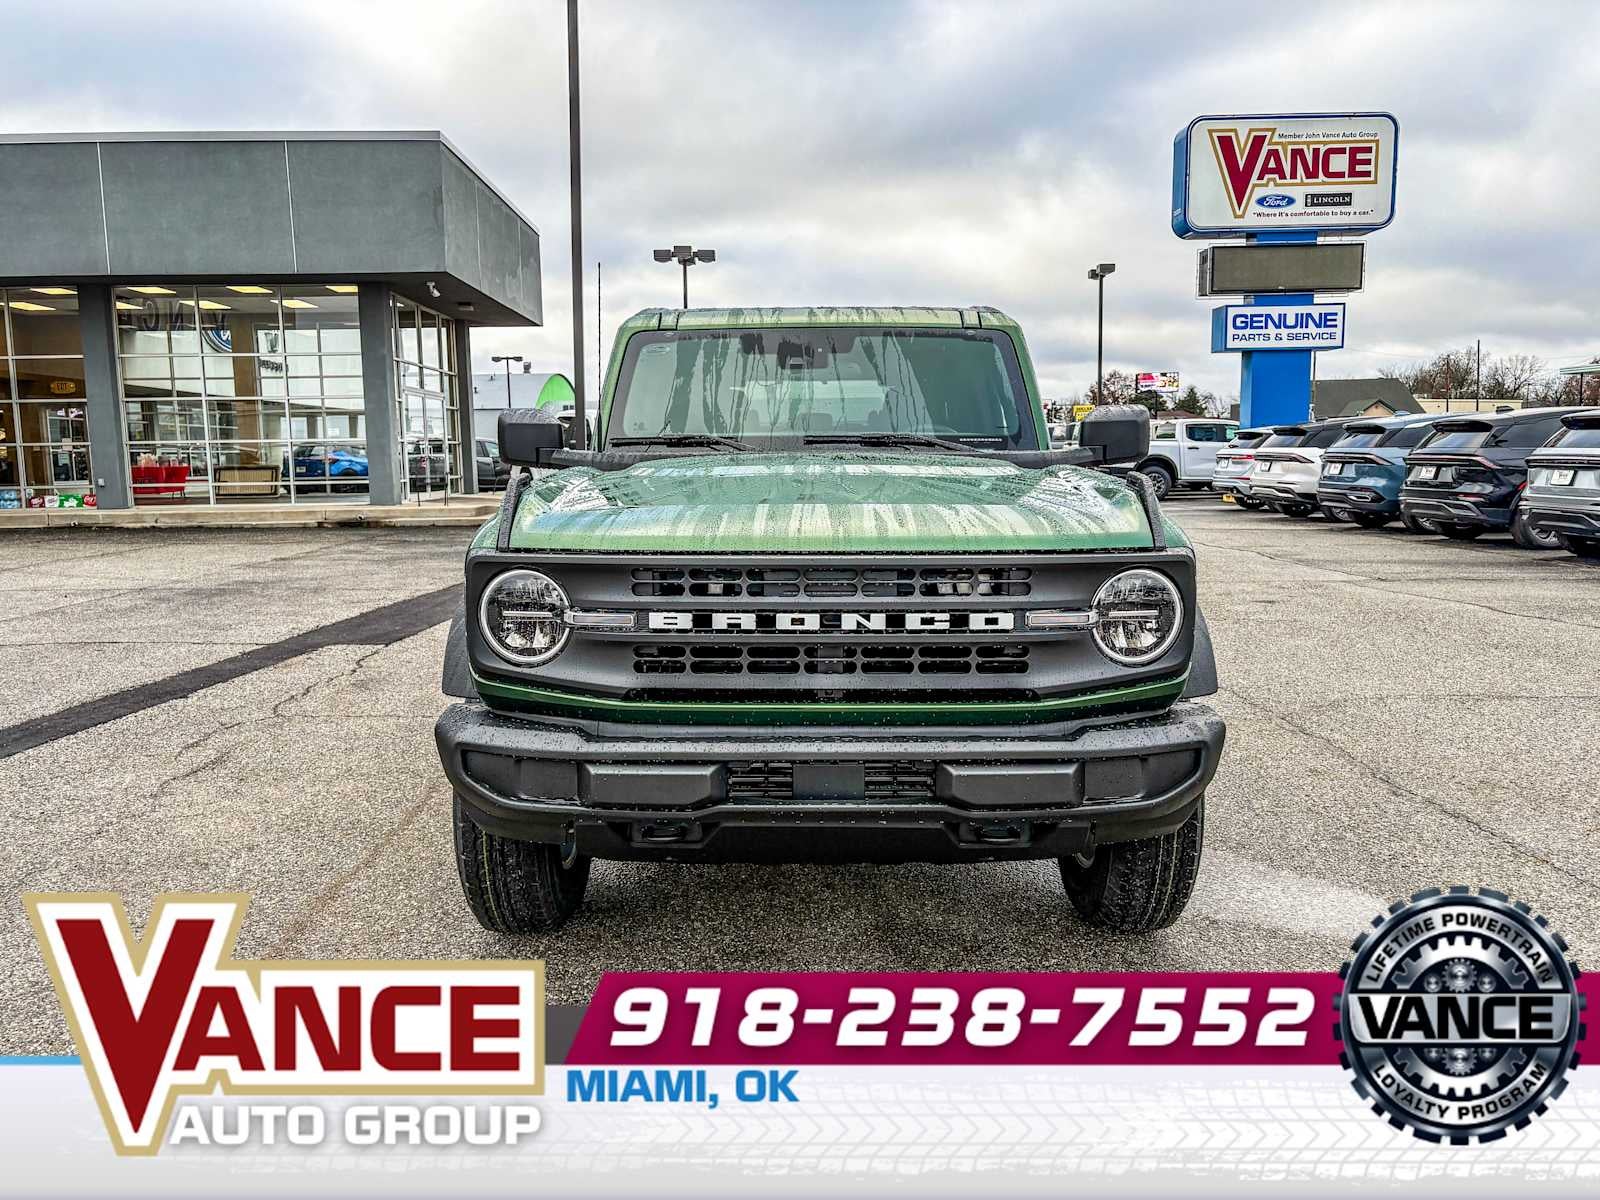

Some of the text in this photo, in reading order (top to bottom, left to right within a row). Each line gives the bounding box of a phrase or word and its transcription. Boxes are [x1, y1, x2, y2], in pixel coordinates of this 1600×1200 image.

[1278, 132, 1304, 140] Member
[1305, 131, 1321, 139] John
[1322, 131, 1341, 139] Vance
[1358, 130, 1378, 139] Group
[1216, 134, 1373, 212] VANCE
[1262, 195, 1289, 207] Ford
[1313, 195, 1351, 204] LINCOLN
[1290, 209, 1330, 217] comfortable
[1331, 209, 1339, 217] to
[1339, 208, 1352, 218] buy
[1231, 311, 1338, 331] GENUINE
[1232, 330, 1337, 342] PARTS & SERVICE
[648, 611, 1015, 631] BRONCO
